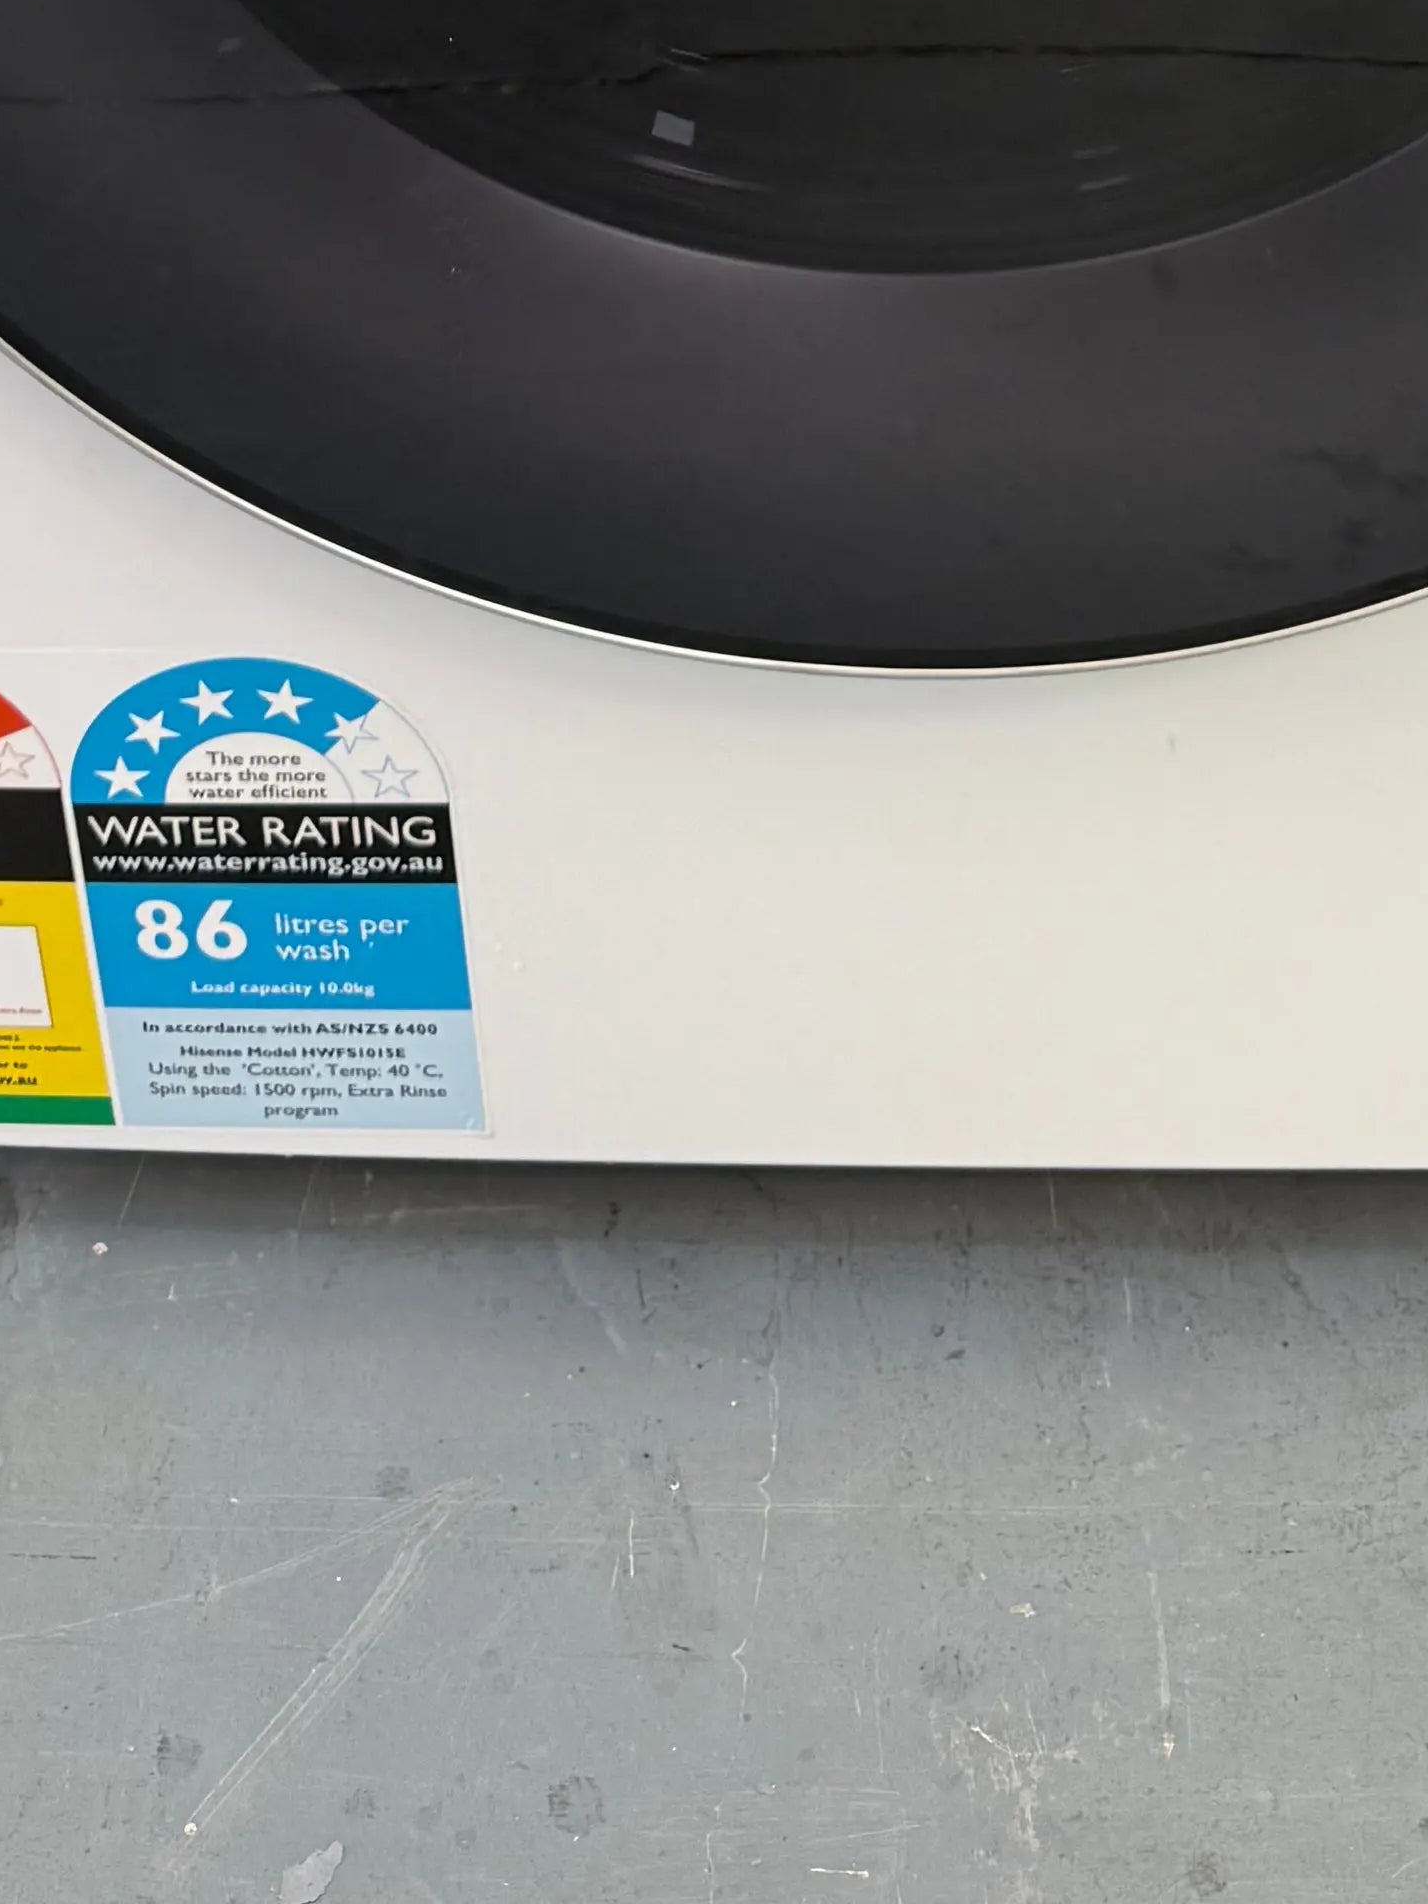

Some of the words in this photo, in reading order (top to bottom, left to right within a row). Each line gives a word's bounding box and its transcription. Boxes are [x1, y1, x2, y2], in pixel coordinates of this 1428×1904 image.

[206, 752, 243, 765] The
[250, 755, 300, 765] more
[187, 770, 232, 782] stars
[238, 769, 271, 782] the
[276, 772, 326, 782] more
[189, 787, 245, 798] water
[251, 785, 327, 798] efficient
[88, 816, 246, 847] WATER
[262, 816, 436, 848] RATING
[93, 854, 442, 877] www.waterrating.gov.au
[135, 899, 248, 961] 86
[275, 913, 348, 935] litres
[360, 917, 409, 942] per
[276, 940, 350, 961] wash
[191, 981, 234, 994] Load
[240, 982, 312, 997] capacity
[319, 981, 374, 997] 10.0kg
[143, 1022, 160, 1033] In
[165, 1023, 267, 1034] accordance
[272, 1022, 312, 1035] with
[316, 1023, 389, 1035] AS/NZS
[395, 1024, 438, 1035] 6400
[180, 1047, 242, 1057] Hisense
[248, 1047, 297, 1058] Model
[149, 1063, 196, 1078] Using
[203, 1063, 230, 1075] the
[325, 1064, 382, 1080] Temp:
[387, 1065, 410, 1077] 40
[150, 1082, 186, 1097] Spin
[192, 1083, 247, 1099] speed:
[254, 1084, 295, 1096] 1500
[301, 1087, 342, 1101] rpm,
[348, 1084, 394, 1097] Extra
[401, 1086, 446, 1097] Rinse
[264, 1105, 338, 1118] program
